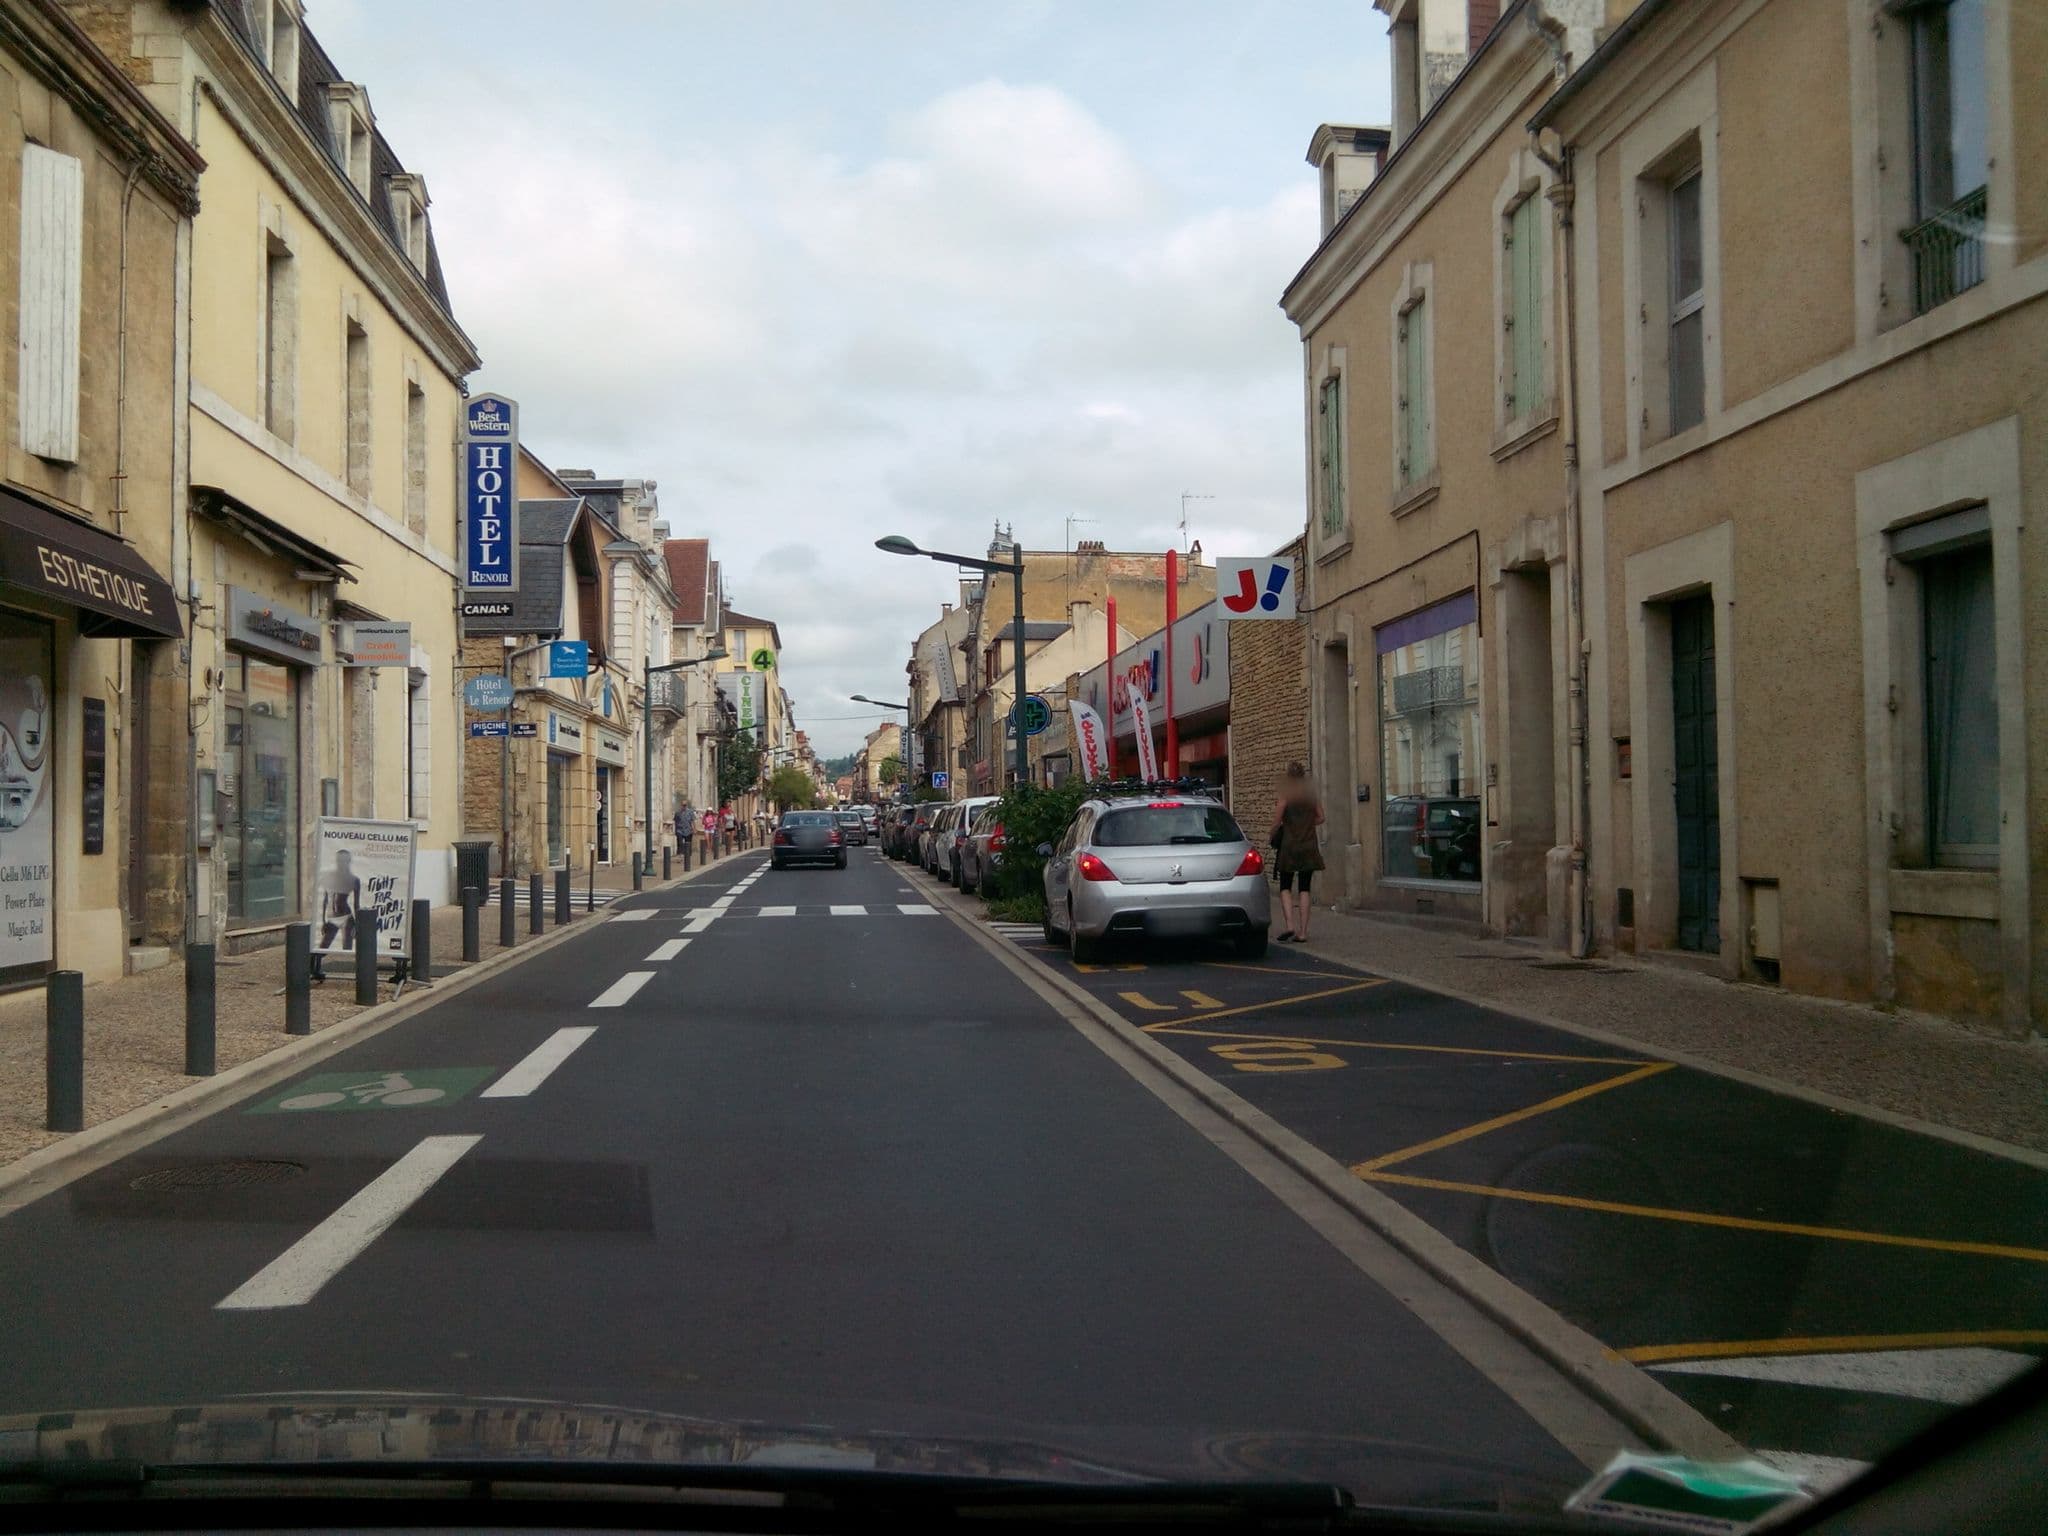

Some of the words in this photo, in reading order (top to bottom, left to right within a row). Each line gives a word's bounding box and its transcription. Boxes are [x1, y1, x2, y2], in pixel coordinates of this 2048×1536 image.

[478, 412, 500, 422] Best
[469, 421, 510, 431] Western
[476, 446, 503, 566] HOTEL
[38, 546, 153, 615] ESTHETIQUE
[464, 603, 510, 615] CANAL+
[754, 650, 771, 669] 4
[476, 679, 502, 690] Hôtel
[469, 696, 481, 706] Le
[482, 694, 511, 705] Renoir
[473, 722, 507, 730] PISCINE
[324, 831, 366, 841] NOUVEAU
[367, 833, 394, 842] CELLU
[395, 835, 409, 843] M6
[0, 866, 19, 882] Cellu
[5, 894, 27, 910] Power
[28, 892, 45, 908] Plate
